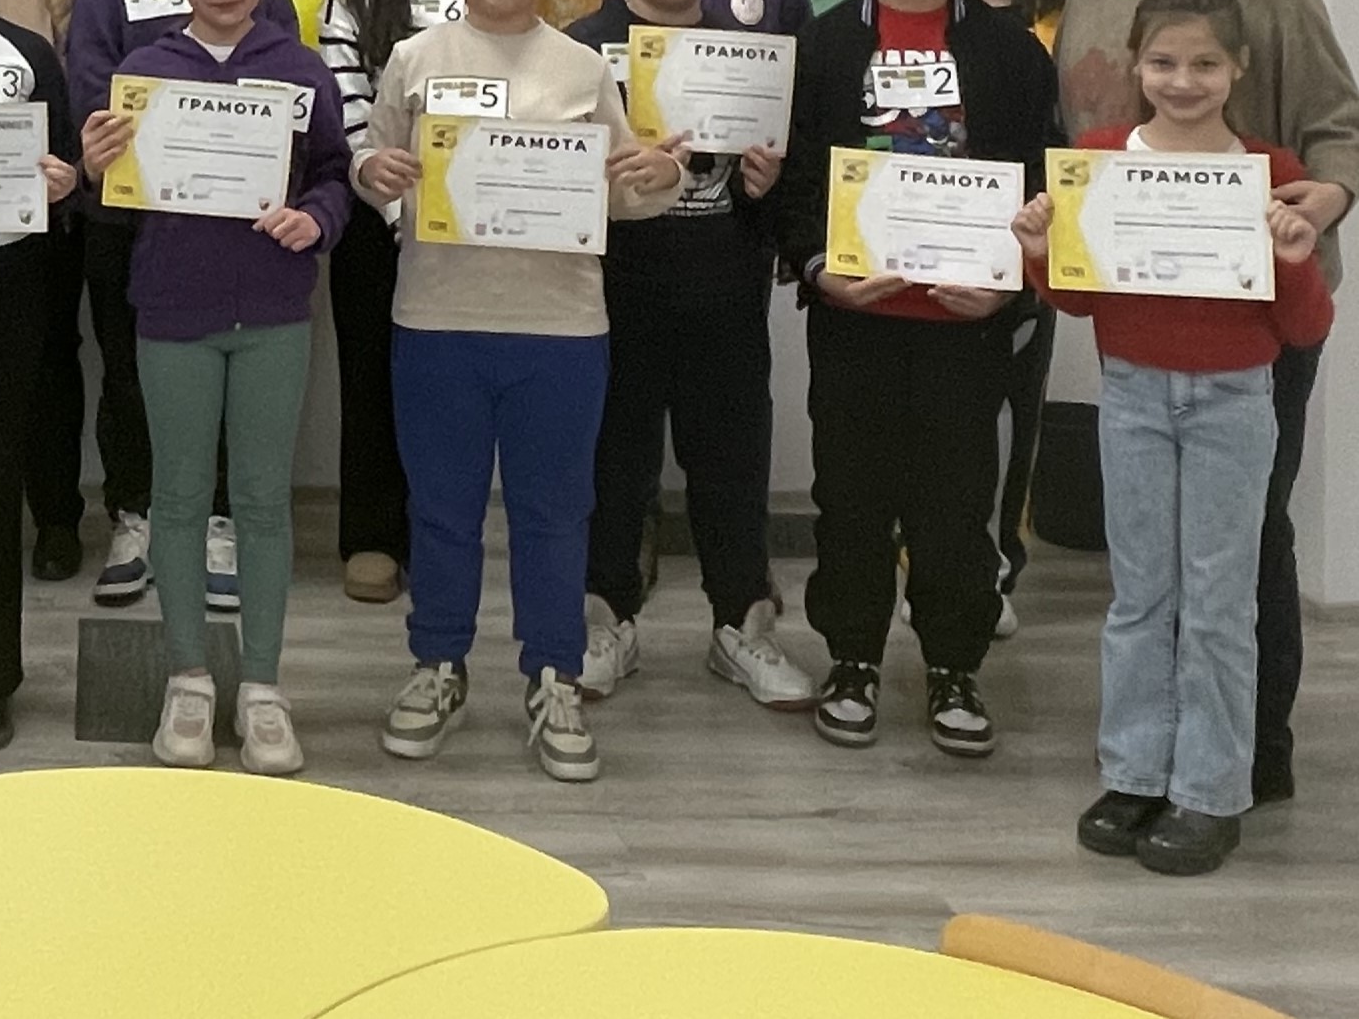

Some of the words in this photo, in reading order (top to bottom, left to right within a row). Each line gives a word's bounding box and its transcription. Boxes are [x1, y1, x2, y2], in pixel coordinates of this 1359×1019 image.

[444, 0, 462, 21] 6
[694, 44, 779, 62] ГРАМОТА
[2, 69, 20, 98] 3
[932, 67, 954, 95] 2
[479, 83, 499, 109] 5
[177, 96, 273, 118] ГРАМОТА
[489, 134, 588, 153] ГРАМОТА
[900, 170, 1001, 190] ГРАМОТА
[1126, 169, 1243, 186] ГРАМОТА
